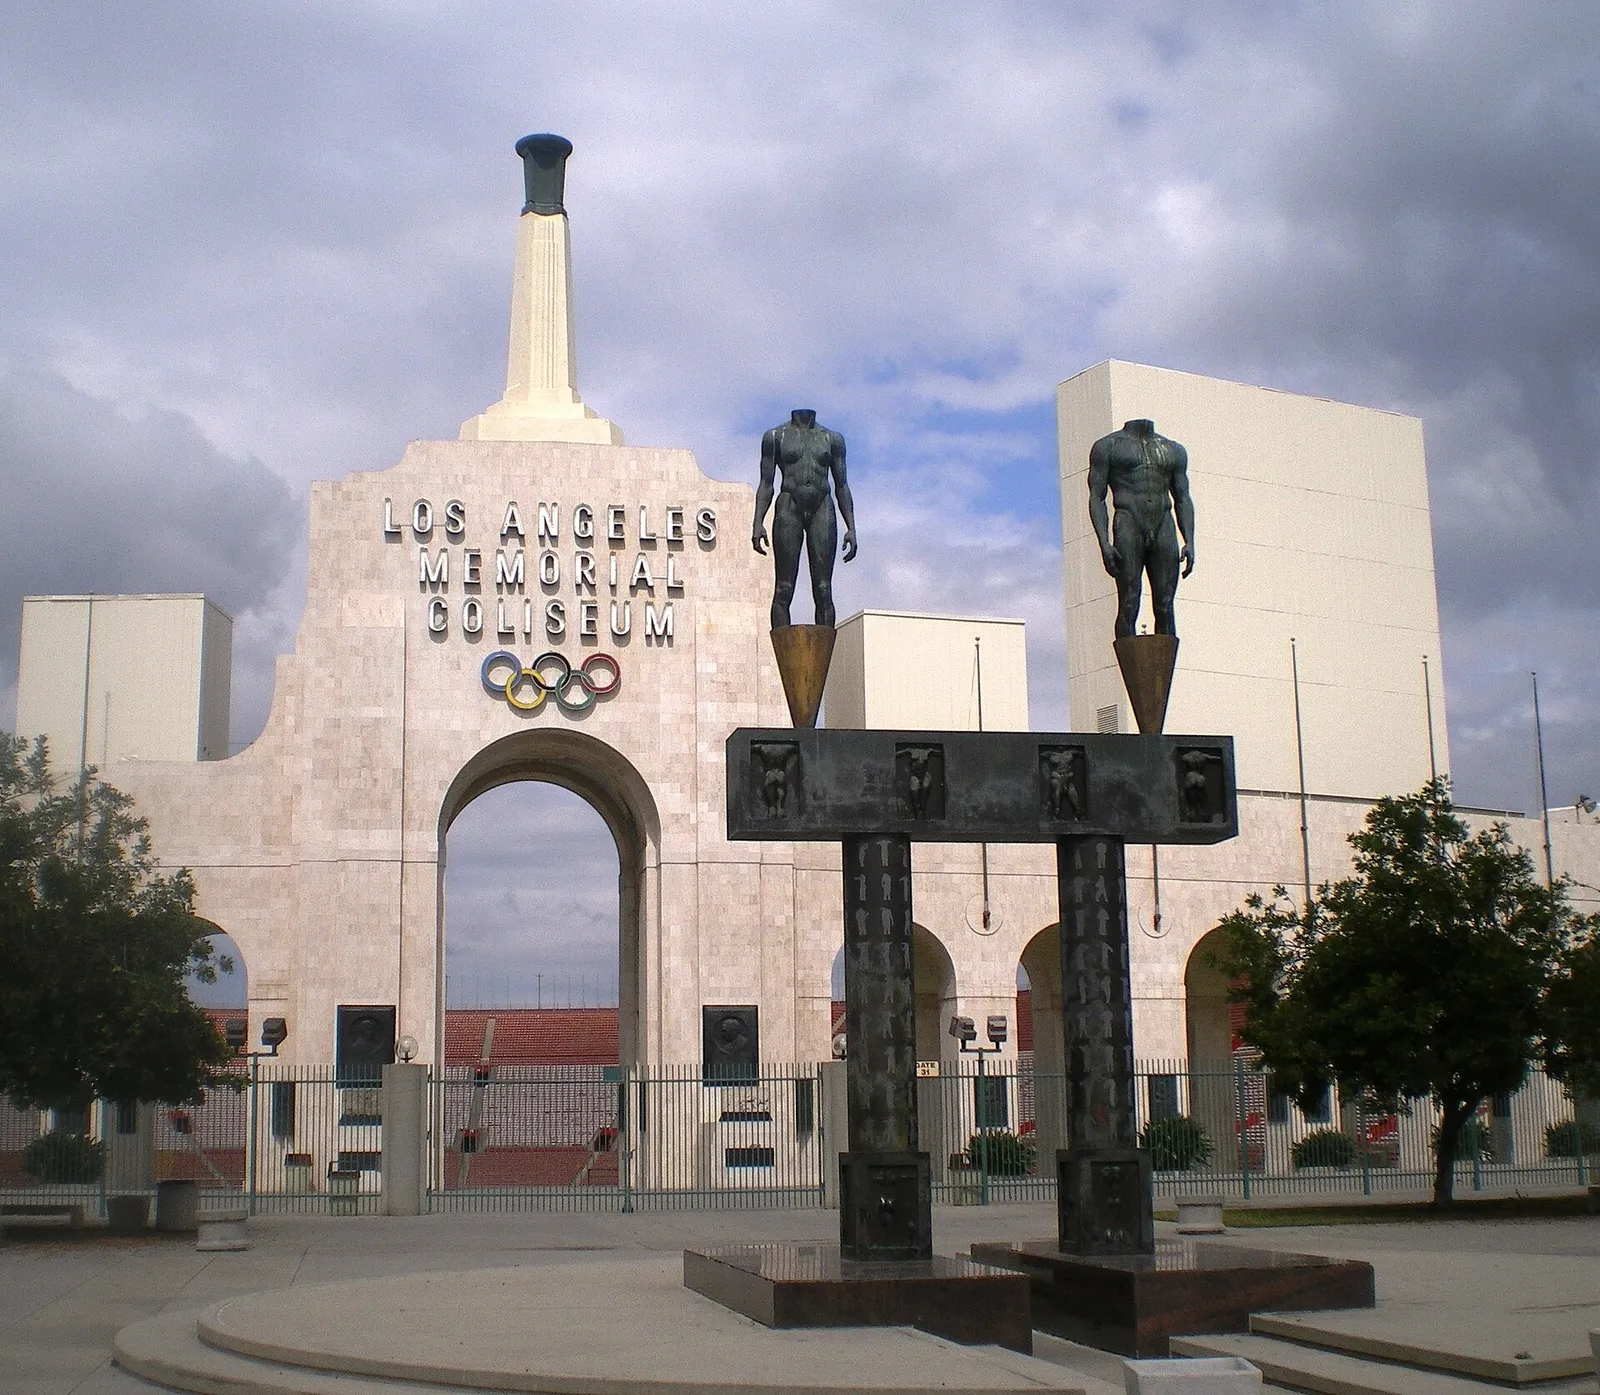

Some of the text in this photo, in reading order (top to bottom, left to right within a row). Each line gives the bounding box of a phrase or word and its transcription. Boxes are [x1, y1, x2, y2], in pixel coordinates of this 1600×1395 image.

[384, 498, 717, 544] LOS ANGELES
[419, 548, 685, 590] MEMORIAL
[428, 597, 675, 639] COLISEUM
